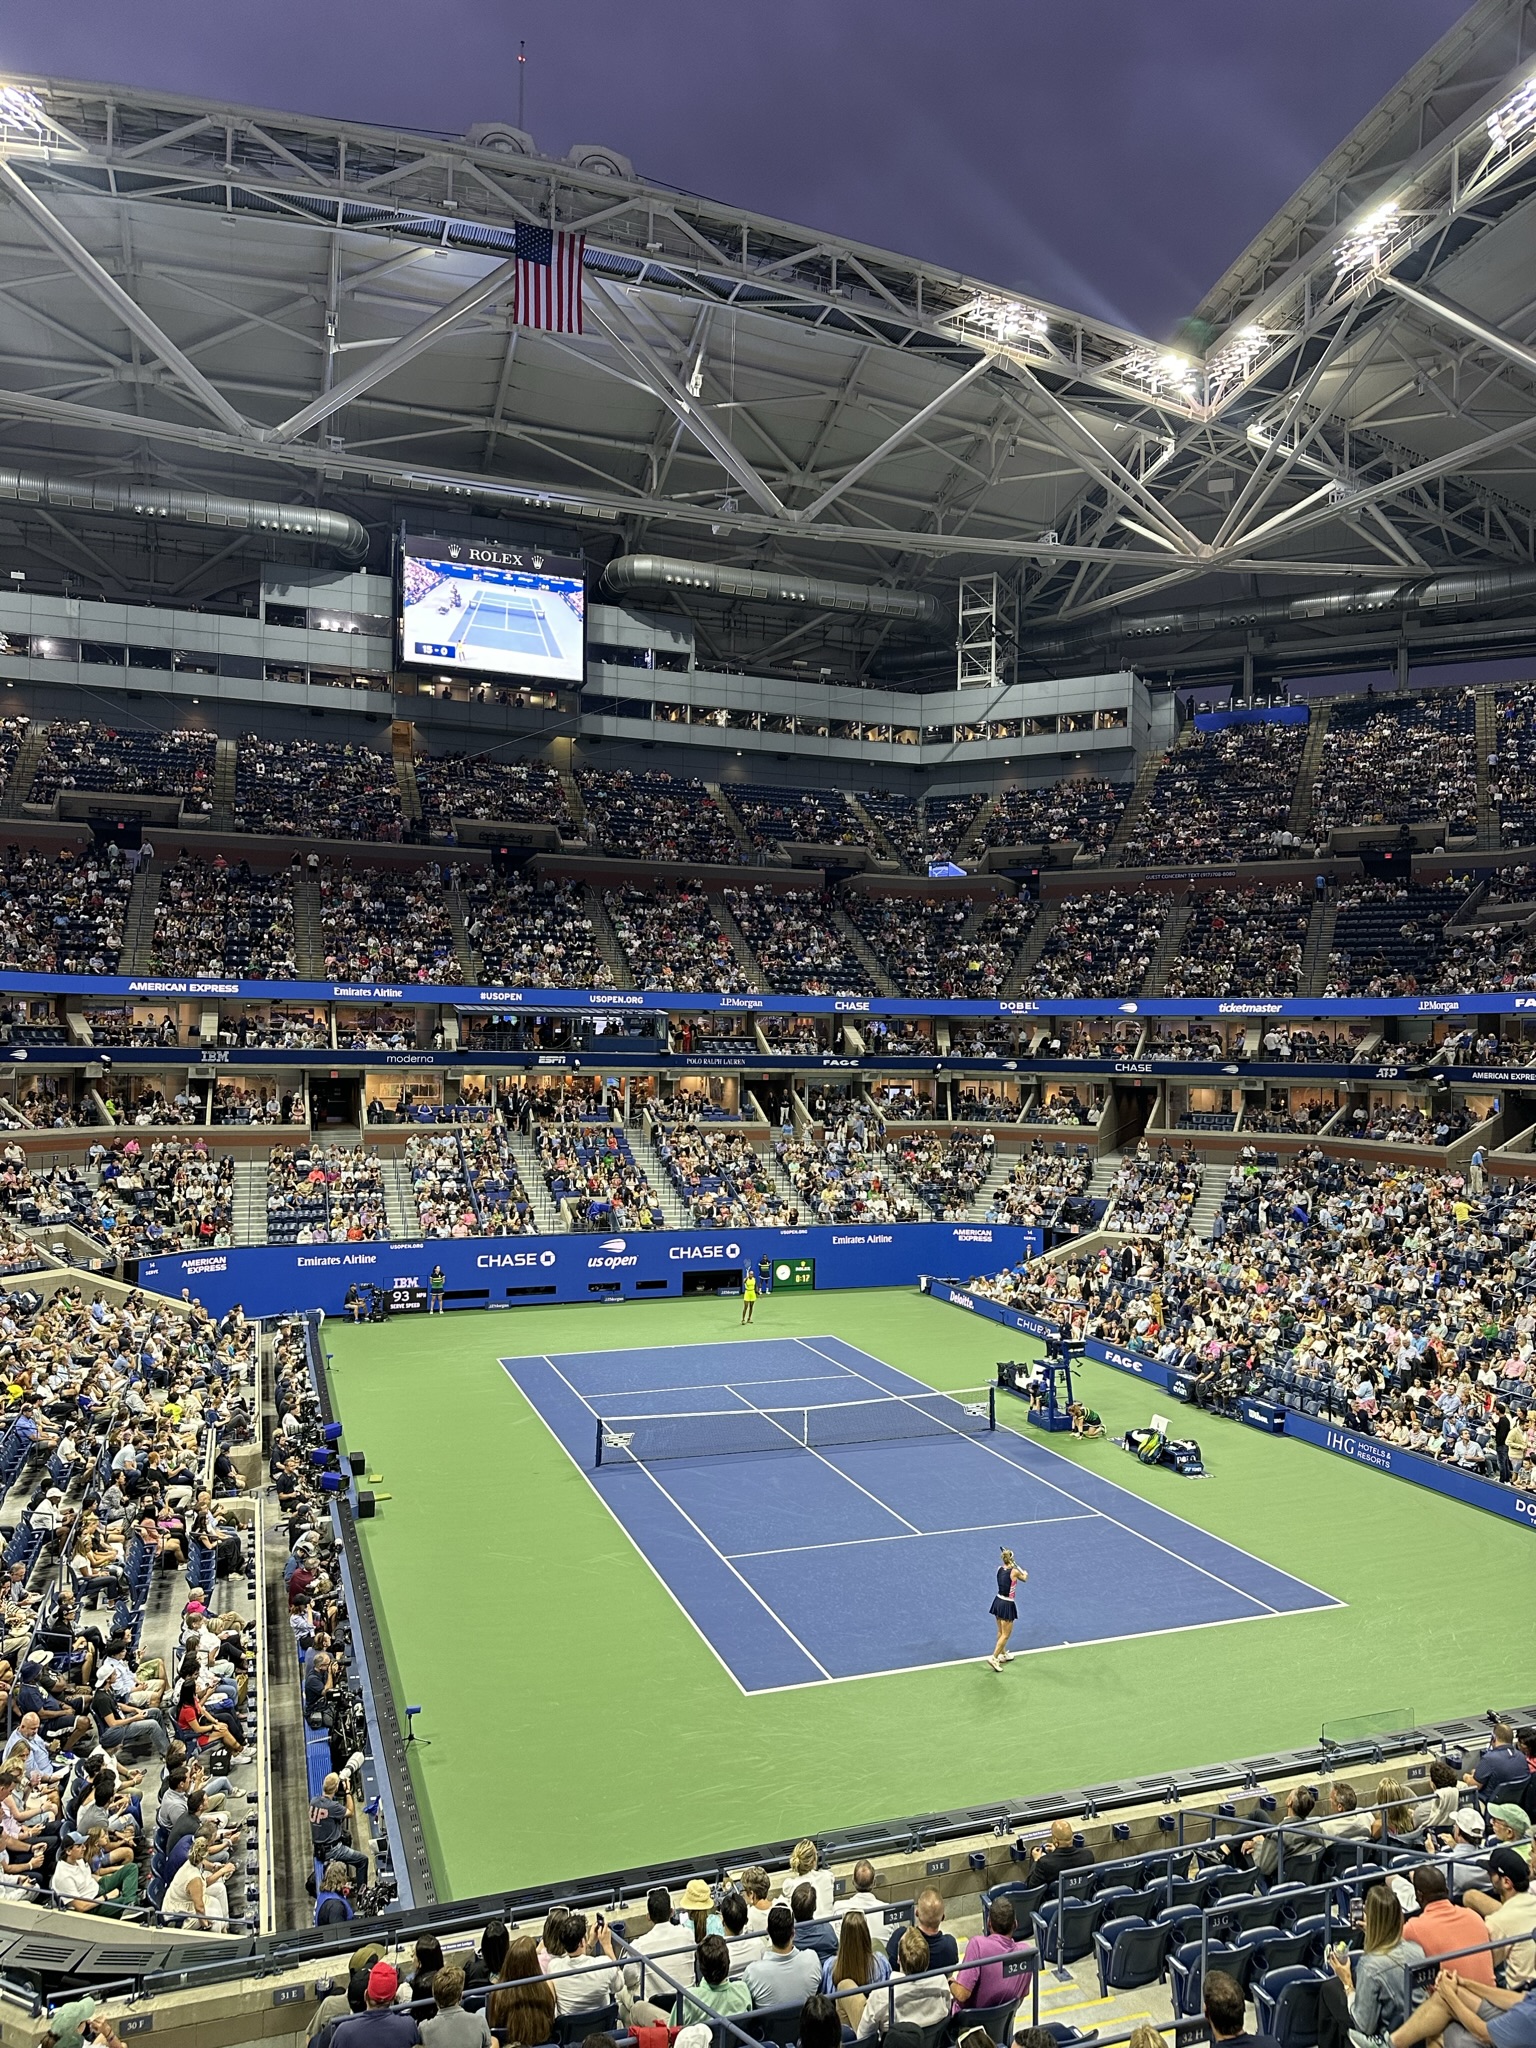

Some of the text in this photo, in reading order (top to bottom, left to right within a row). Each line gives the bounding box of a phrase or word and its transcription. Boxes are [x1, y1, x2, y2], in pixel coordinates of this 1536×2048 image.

[469, 548, 524, 567] ROLEX
[421, 644, 433, 654] 15
[440, 647, 448, 656] 0
[128, 982, 239, 993] AMERICAN EXPRESS
[333, 986, 403, 998] Emirates Airline
[479, 992, 523, 1001] #USOPEN
[589, 994, 644, 1005] USOPEN.ORG
[834, 1001, 870, 1011] CHASE
[999, 1001, 1040, 1010] DOBEL
[1218, 1002, 1283, 1014] ticketmaster
[201, 1050, 230, 1063] IBM
[386, 1054, 434, 1063] moderna
[538, 1055, 567, 1064] ESPN
[1115, 1063, 1153, 1072] CHASE
[1375, 1067, 1398, 1078] ATP
[1472, 1071, 1510, 1080] AMERICAN
[952, 1228, 993, 1237] AMERICAN
[958, 1234, 993, 1243] EXPRESS
[832, 1234, 893, 1245] Emirates Airline
[669, 1245, 724, 1260] CHASE
[181, 1256, 227, 1268] AMERICAN
[297, 1254, 377, 1267] Emirates Airline
[476, 1252, 538, 1268] CHASE
[587, 1255, 637, 1269] us open
[187, 1263, 227, 1275] EXPRESS
[393, 1276, 420, 1289] IBM
[392, 1290, 410, 1303] 93
[390, 1302, 405, 1310] SERVE
[1326, 1431, 1357, 1455] IHG
[1357, 1441, 1386, 1458] HOTELS
[1356, 1450, 1391, 1469] RESORTS
[309, 1805, 329, 1824] UP
[931, 1864, 939, 1872] 33
[835, 1883, 841, 1891] E
[1069, 1877, 1083, 1886] 33 F
[889, 1911, 904, 1921] 32 F
[1212, 1915, 1229, 1928] 33 G
[1008, 1962, 1027, 1974] 32 G
[1417, 1971, 1427, 1982] 33
[280, 1989, 298, 2001] 31 E
[127, 2020, 144, 2031] 30 F
[1181, 2030, 1204, 2044] 32 H
